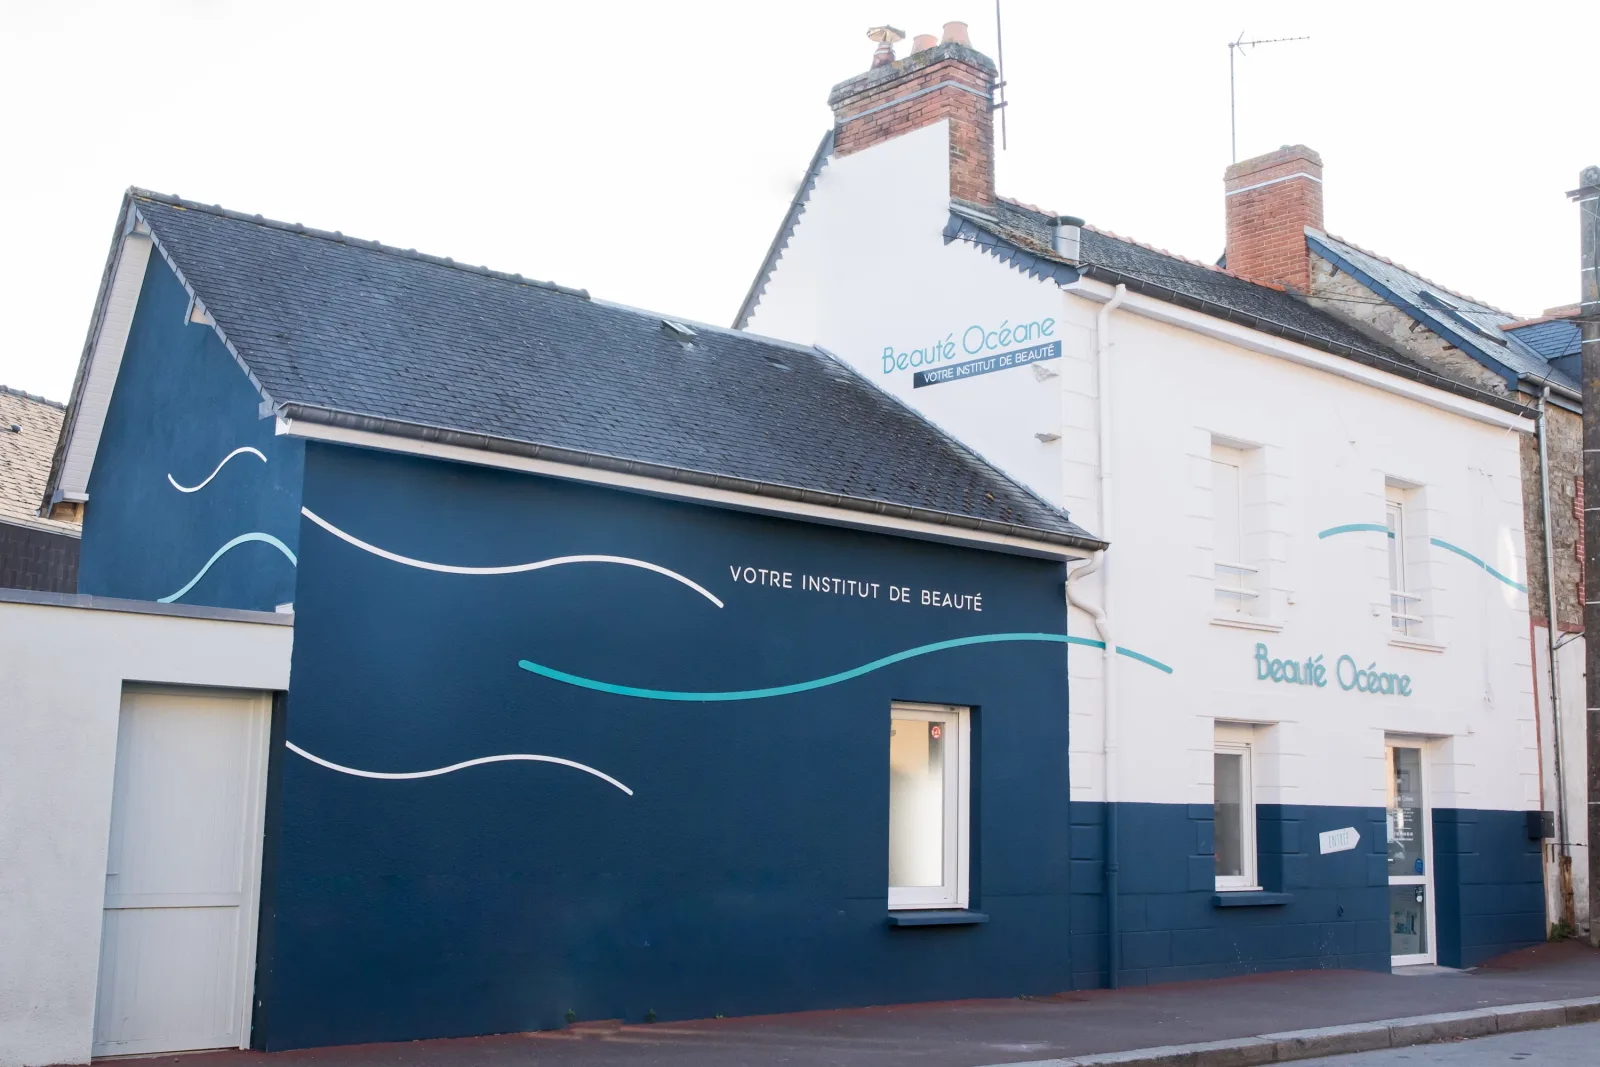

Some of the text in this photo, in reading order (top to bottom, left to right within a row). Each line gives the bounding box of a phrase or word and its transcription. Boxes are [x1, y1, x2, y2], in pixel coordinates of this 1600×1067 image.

[882, 317, 1056, 374] Beauté Océane
[924, 344, 1055, 383] VOTRE INSTITUT DE BEAUTÉ
[730, 565, 983, 612] VOTRE INSTITUT DE BEAUTÉ
[1254, 642, 1413, 697] Beauté Océane
